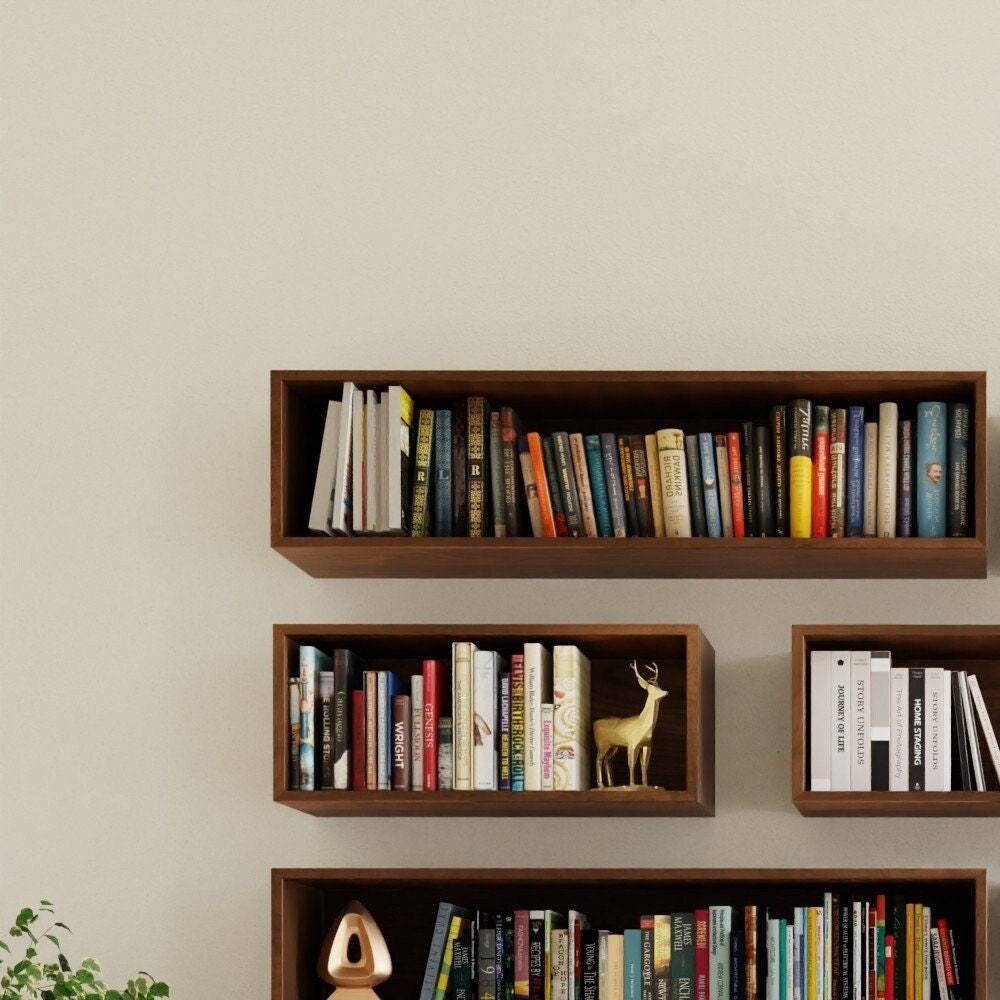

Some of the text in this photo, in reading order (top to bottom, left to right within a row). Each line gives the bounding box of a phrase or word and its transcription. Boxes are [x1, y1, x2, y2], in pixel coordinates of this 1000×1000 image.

[417, 470, 425, 481] R
[471, 464, 480, 476] R
[322, 705, 331, 742] ROLLING
[335, 691, 346, 742] Caravaggio
[413, 708, 423, 762] FULLMOON
[424, 703, 434, 748] GENESIS
[501, 677, 509, 780] DAVID LACHAPELLE HEAVEN TO HELL
[837, 684, 845, 753] JOURNEY OF LIFE
[857, 680, 865, 766] STORY UNFOLDS
[896, 718, 903, 728] of
[913, 698, 922, 766] HOME STAGING
[394, 721, 405, 769] WRIGHT
[541, 719, 552, 779] Exquisite Mayhem
[895, 728, 904, 779] Photography
[674, 916, 683, 952] MAXWELL
[683, 923, 692, 946] JAMES
[453, 941, 462, 969] MAXWELL
[461, 946, 469, 965] JAMES
[531, 941, 541, 968] RECIPES
[586, 942, 595, 965] YOUNG
[643, 941, 652, 986] GARGOYLE
[531, 968, 541, 977] BY
[584, 971, 596, 984] THE
